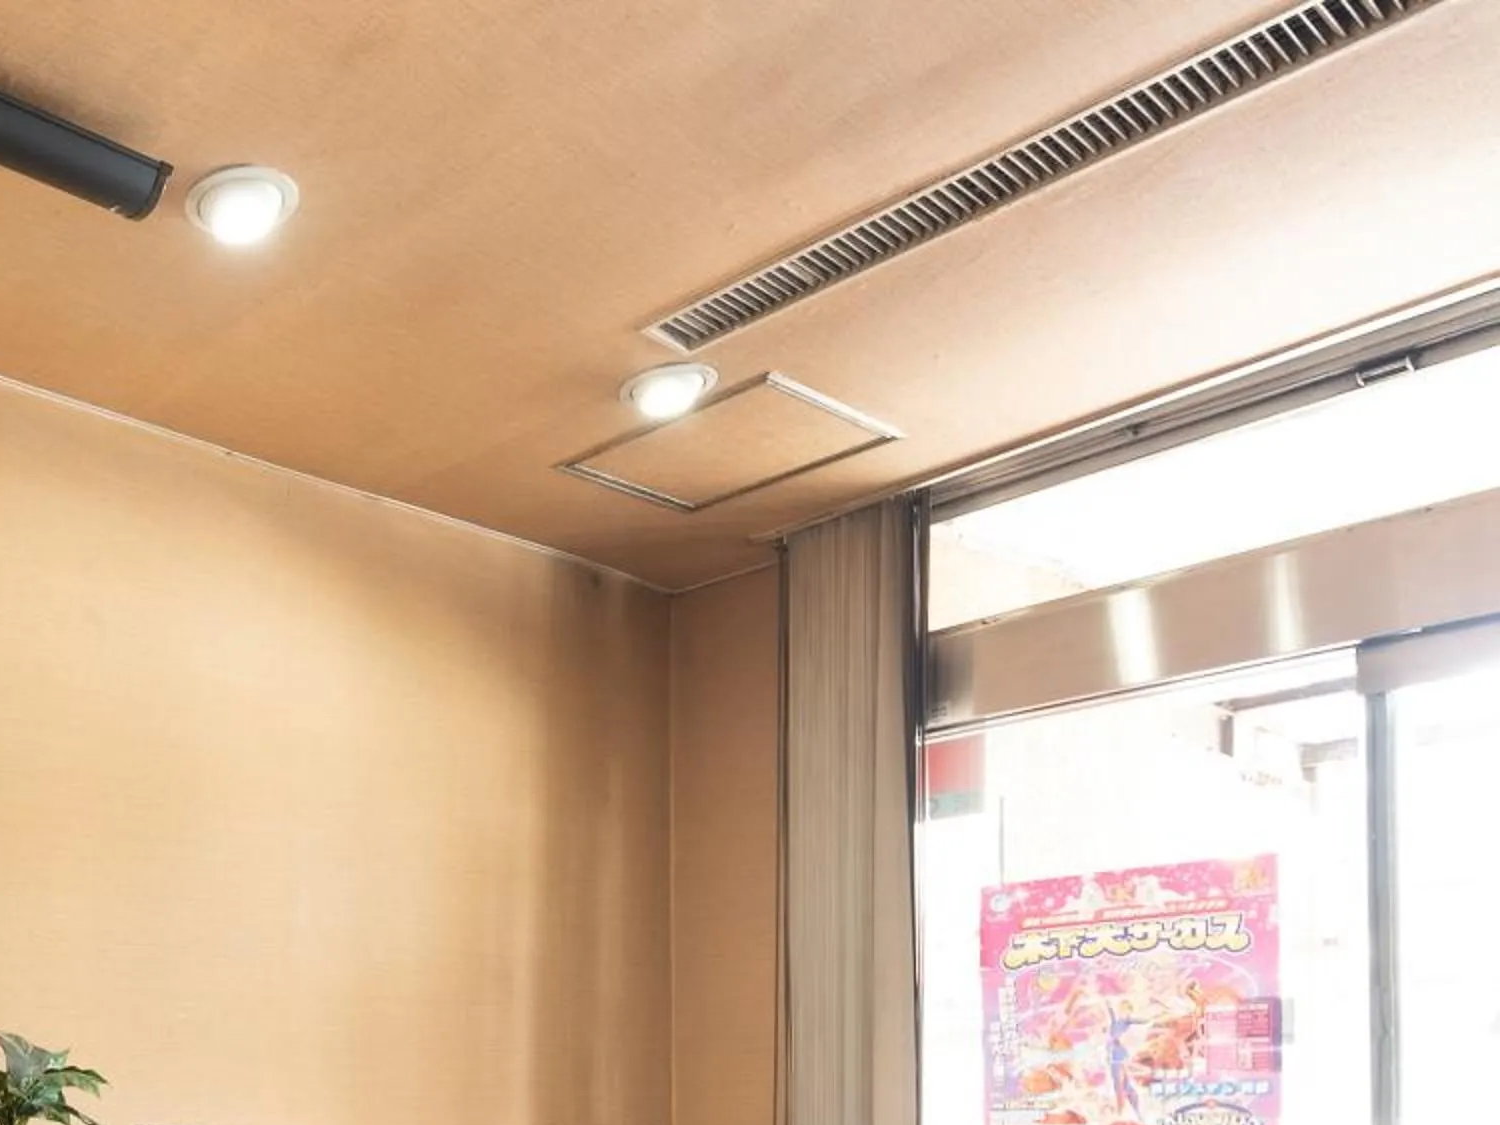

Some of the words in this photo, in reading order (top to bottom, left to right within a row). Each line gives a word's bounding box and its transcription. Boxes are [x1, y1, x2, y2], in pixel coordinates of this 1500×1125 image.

[1003, 914, 1251, 970] 木下大サーカス
